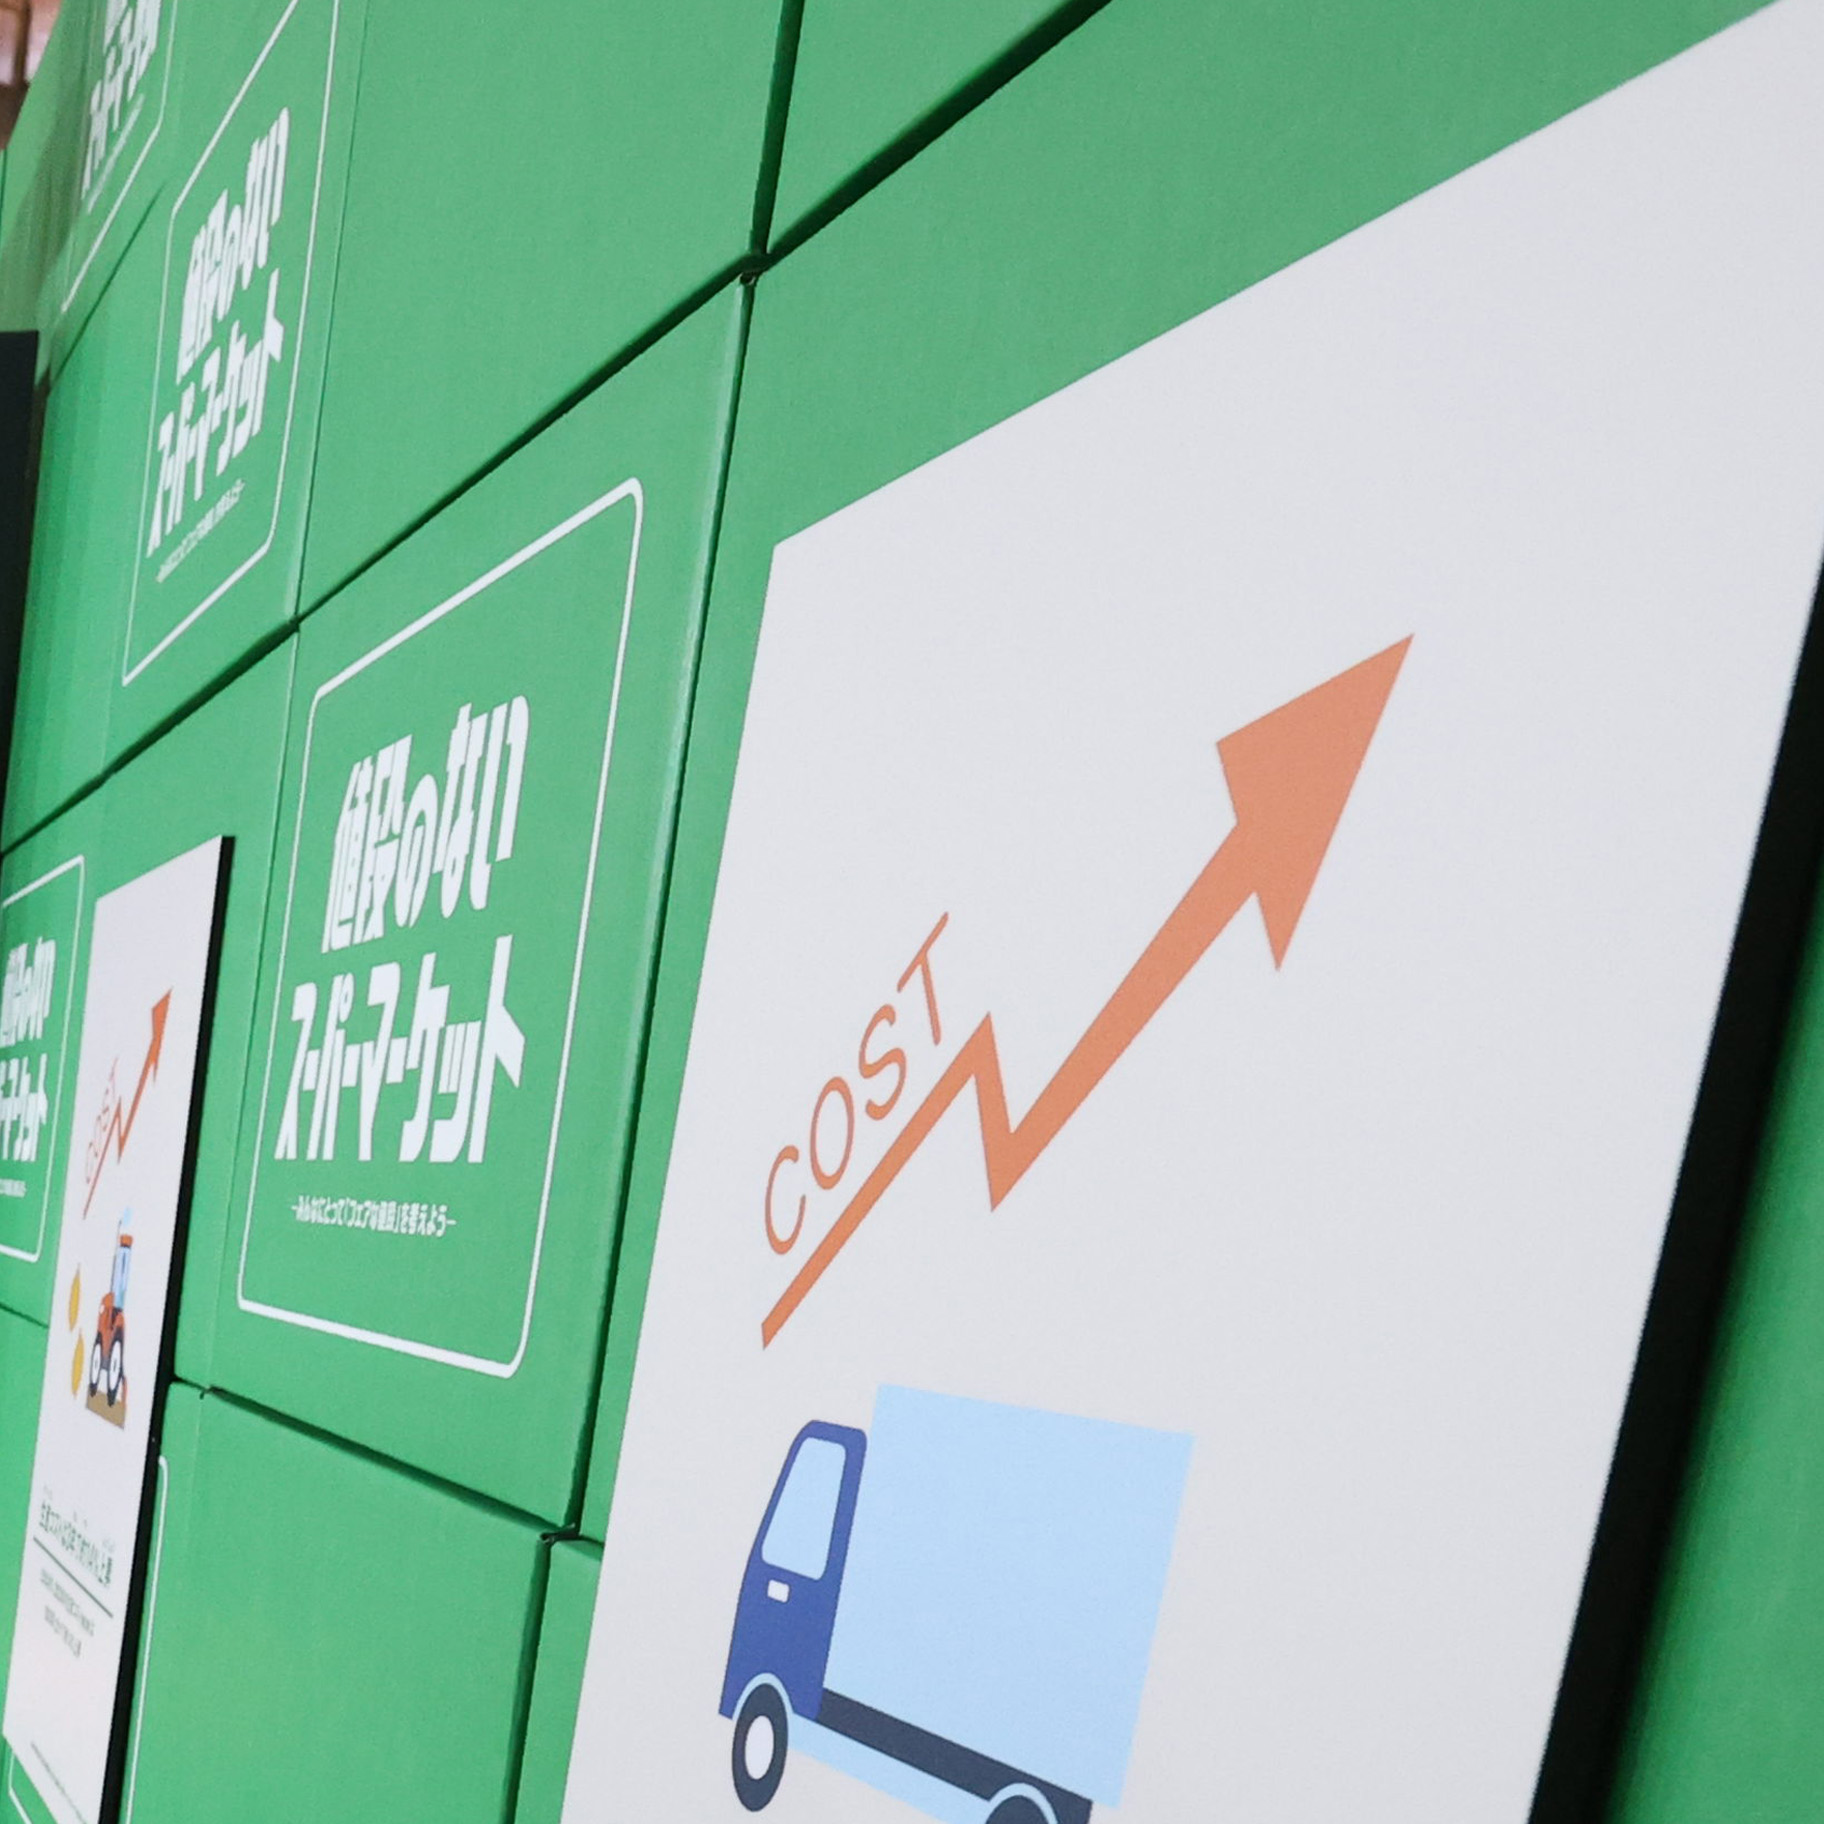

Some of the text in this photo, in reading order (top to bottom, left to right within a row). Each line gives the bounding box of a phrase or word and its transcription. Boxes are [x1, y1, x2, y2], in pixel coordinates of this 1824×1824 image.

[147, 267, 285, 559] スーパーマーケット
[321, 695, 529, 953] 値段のない
[274, 934, 526, 1164] スーパーマーケット
[764, 911, 949, 1255] COST
